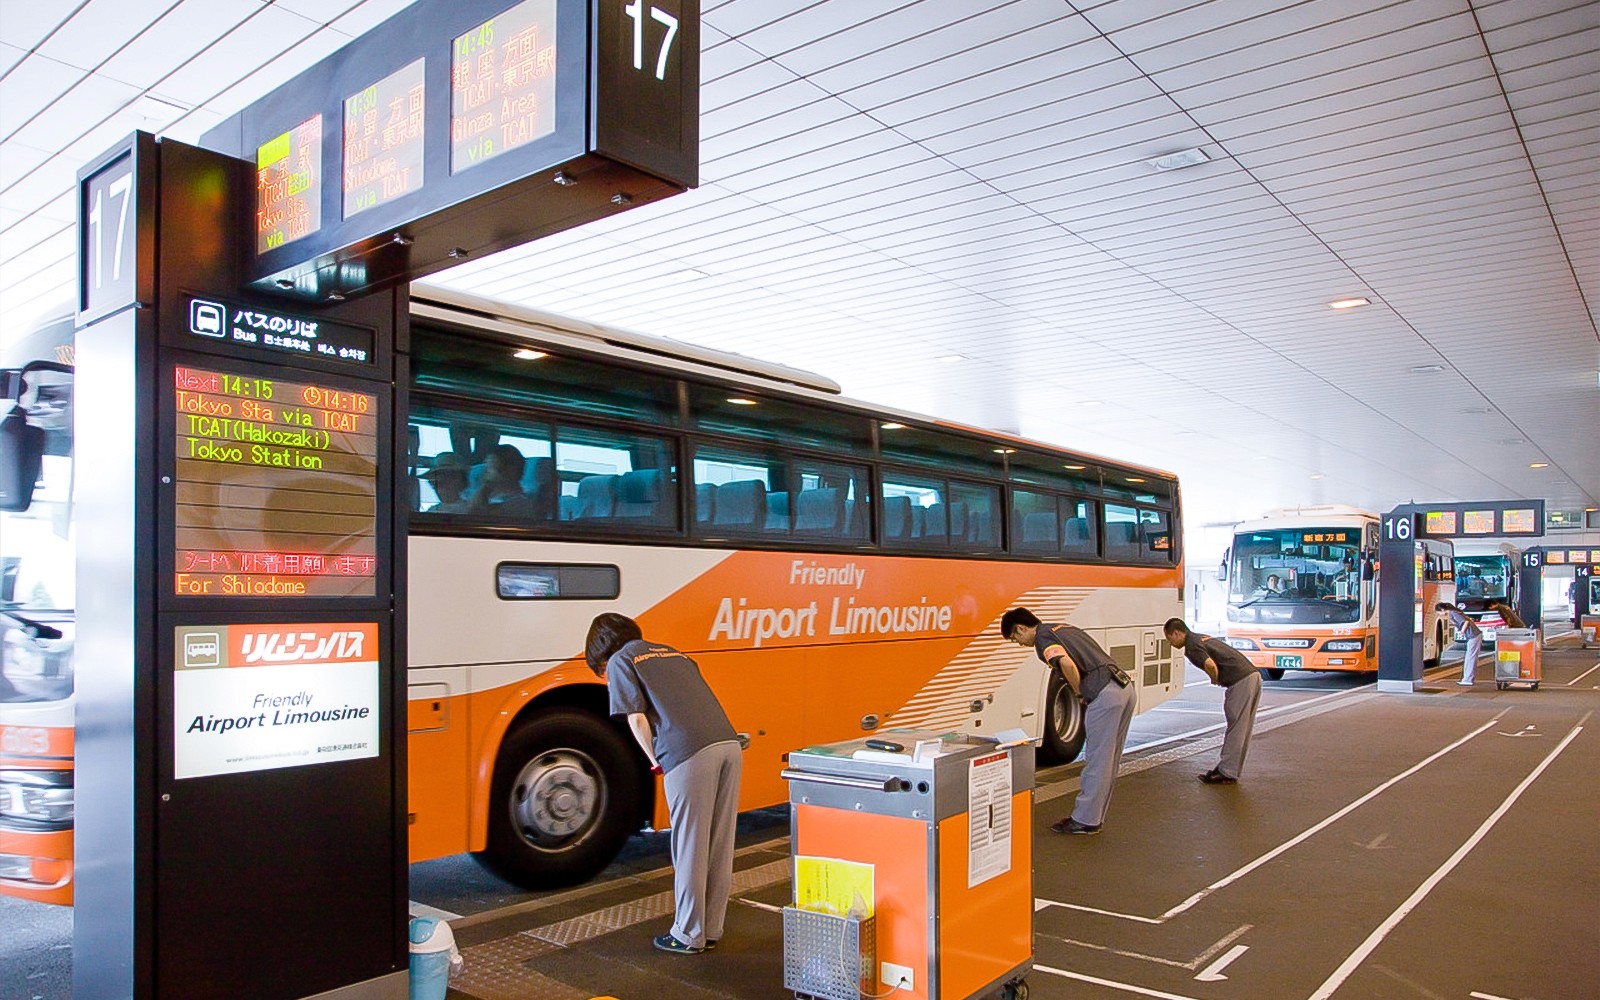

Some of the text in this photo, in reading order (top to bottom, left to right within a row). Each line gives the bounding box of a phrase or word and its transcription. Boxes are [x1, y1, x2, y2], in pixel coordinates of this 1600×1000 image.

[455, 20, 494, 60] 14:45
[625, 0, 679, 80] 17
[345, 86, 377, 118] 14:30
[452, 91, 536, 143] Ginza Area
[468, 113, 536, 161] via TCAT
[356, 168, 410, 209] via TCAT
[90, 171, 132, 289] 17
[266, 212, 310, 247] via TCAT
[232, 327, 257, 343] Bus
[233, 310, 319, 338] バスのりば
[176, 367, 368, 413] Next 14:15 14:16
[176, 391, 359, 432] Tokyo Sta via TCAT
[187, 415, 330, 450] TCAT(Hakozaki)
[187, 437, 323, 470] Tokyo Station
[1385, 518, 1410, 539] 16
[789, 560, 865, 589] Friendly
[1523, 554, 1539, 567] 15
[1576, 568, 1588, 577] 14
[176, 573, 306, 594] For Shiodome
[707, 596, 952, 648] Airport Limousine
[241, 631, 364, 662] リムジンバス
[252, 691, 314, 709] Friendly
[186, 704, 370, 734] Airport Limousine
